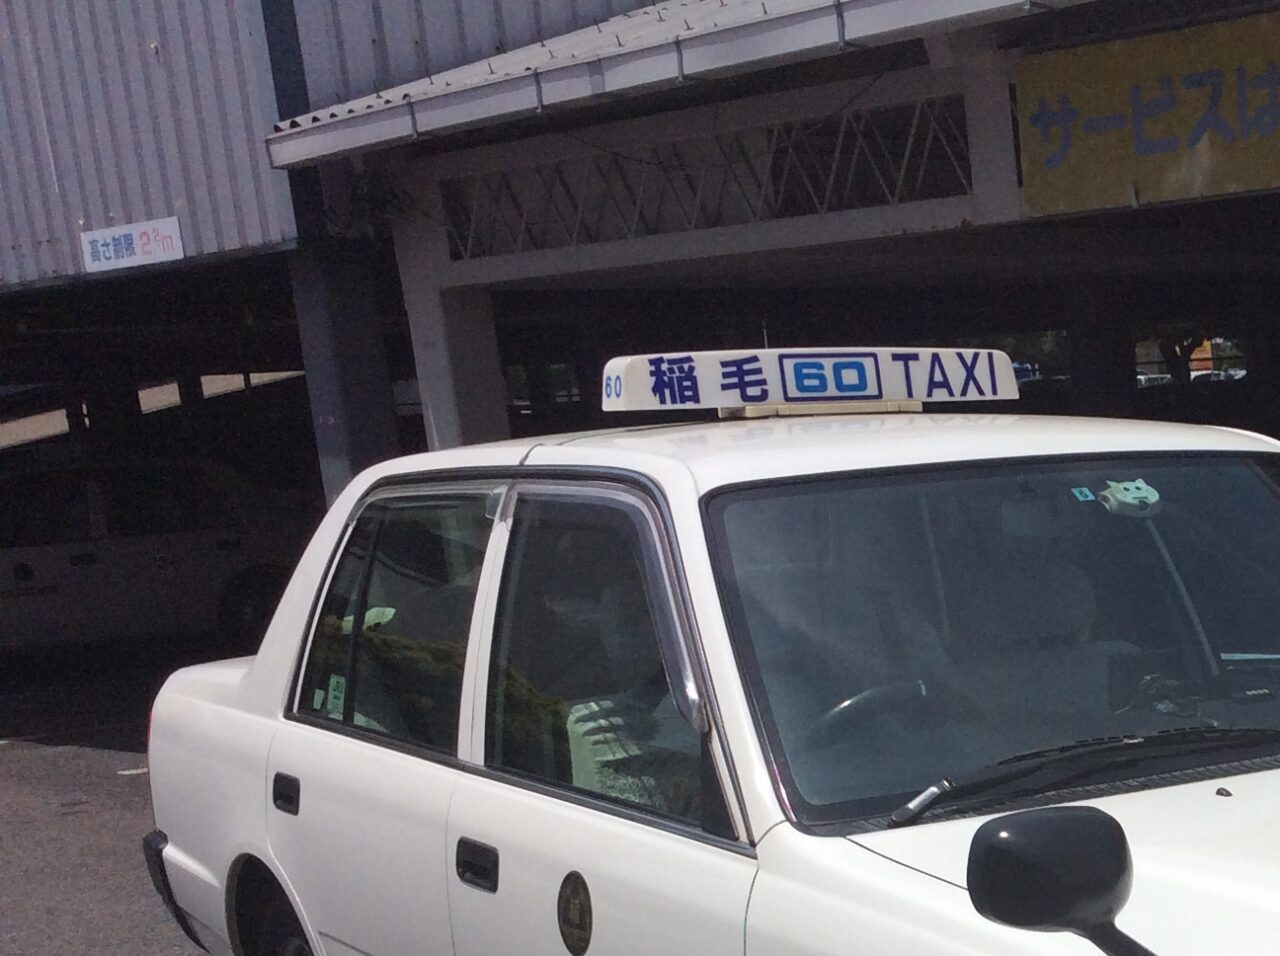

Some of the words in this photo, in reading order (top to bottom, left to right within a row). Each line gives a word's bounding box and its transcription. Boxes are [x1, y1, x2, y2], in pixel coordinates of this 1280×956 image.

[604, 376, 622, 399] 60
[648, 354, 770, 405] 稲毛
[793, 360, 869, 394] 60
[891, 351, 999, 399] TAXI
